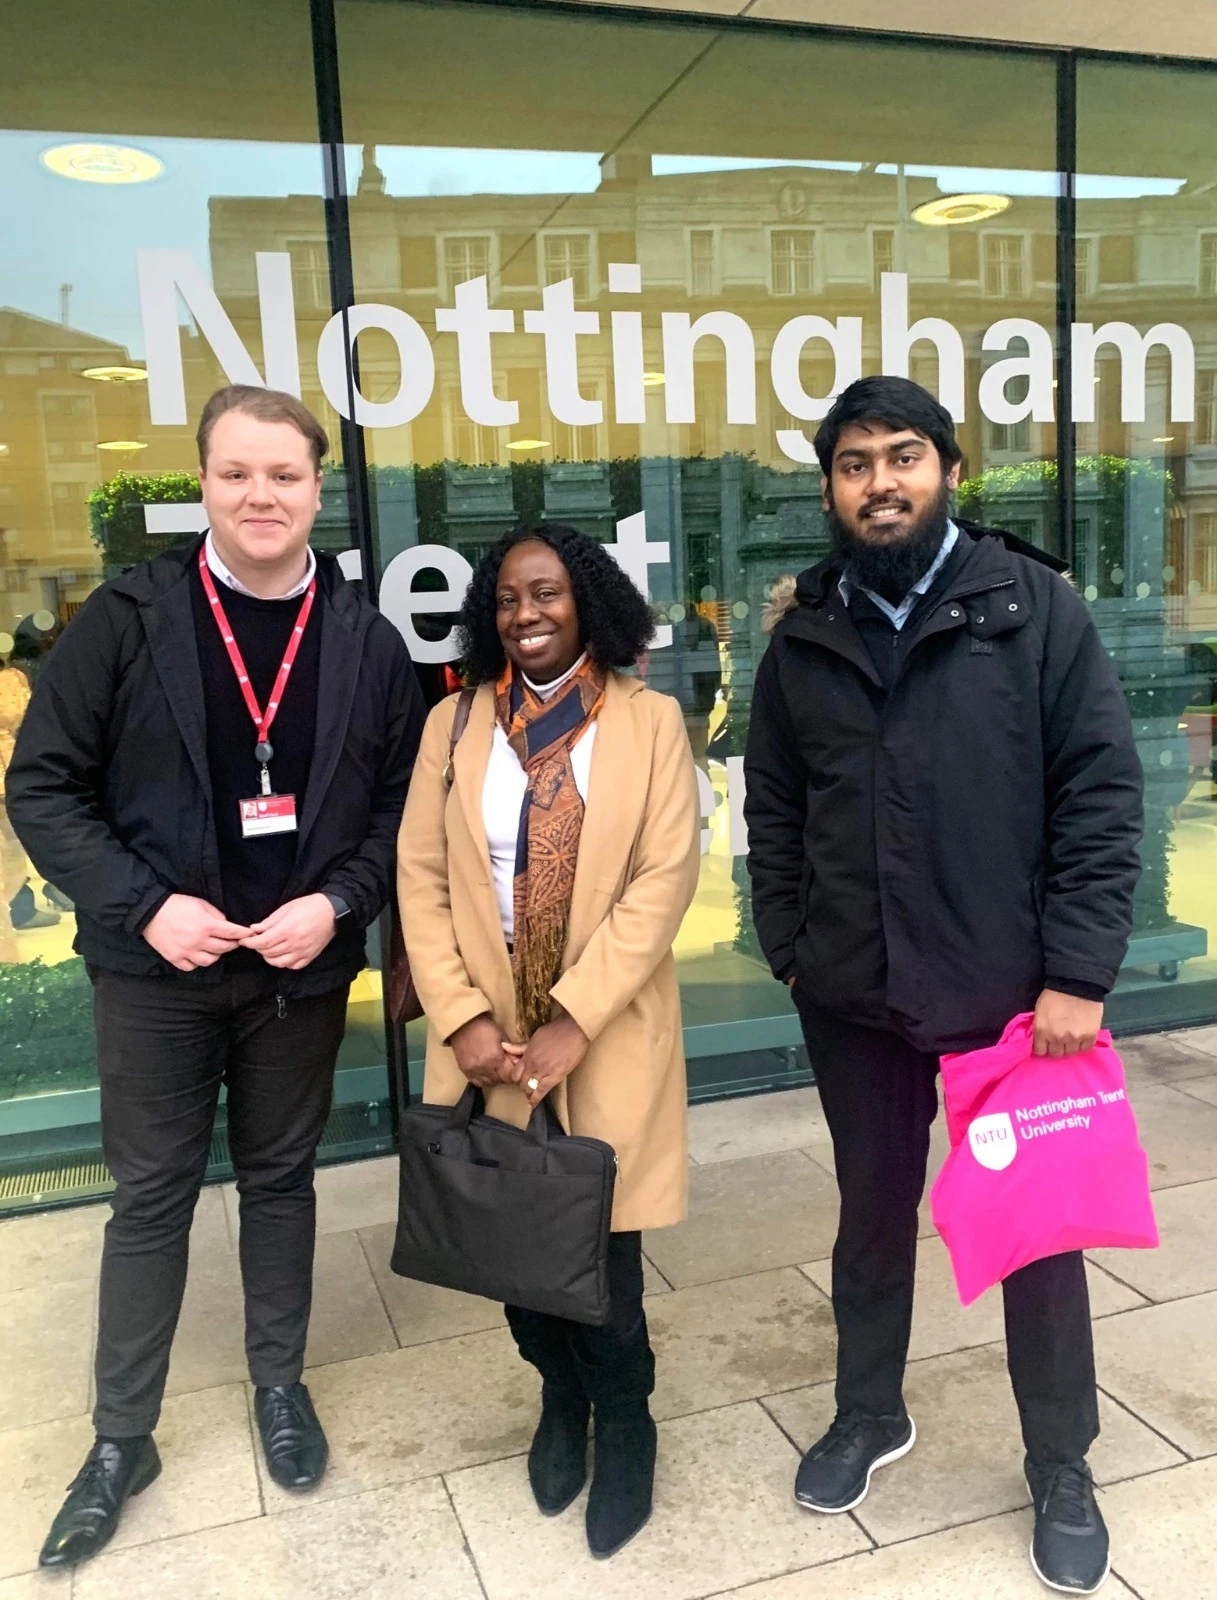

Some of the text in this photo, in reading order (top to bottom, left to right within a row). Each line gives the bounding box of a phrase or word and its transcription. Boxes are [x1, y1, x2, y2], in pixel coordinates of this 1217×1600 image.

[136, 248, 1195, 464] Nottingham
[1015, 1088, 1126, 1123] Nottingham Trent
[974, 1127, 1008, 1145] NTU
[1020, 1114, 1091, 1140] University
